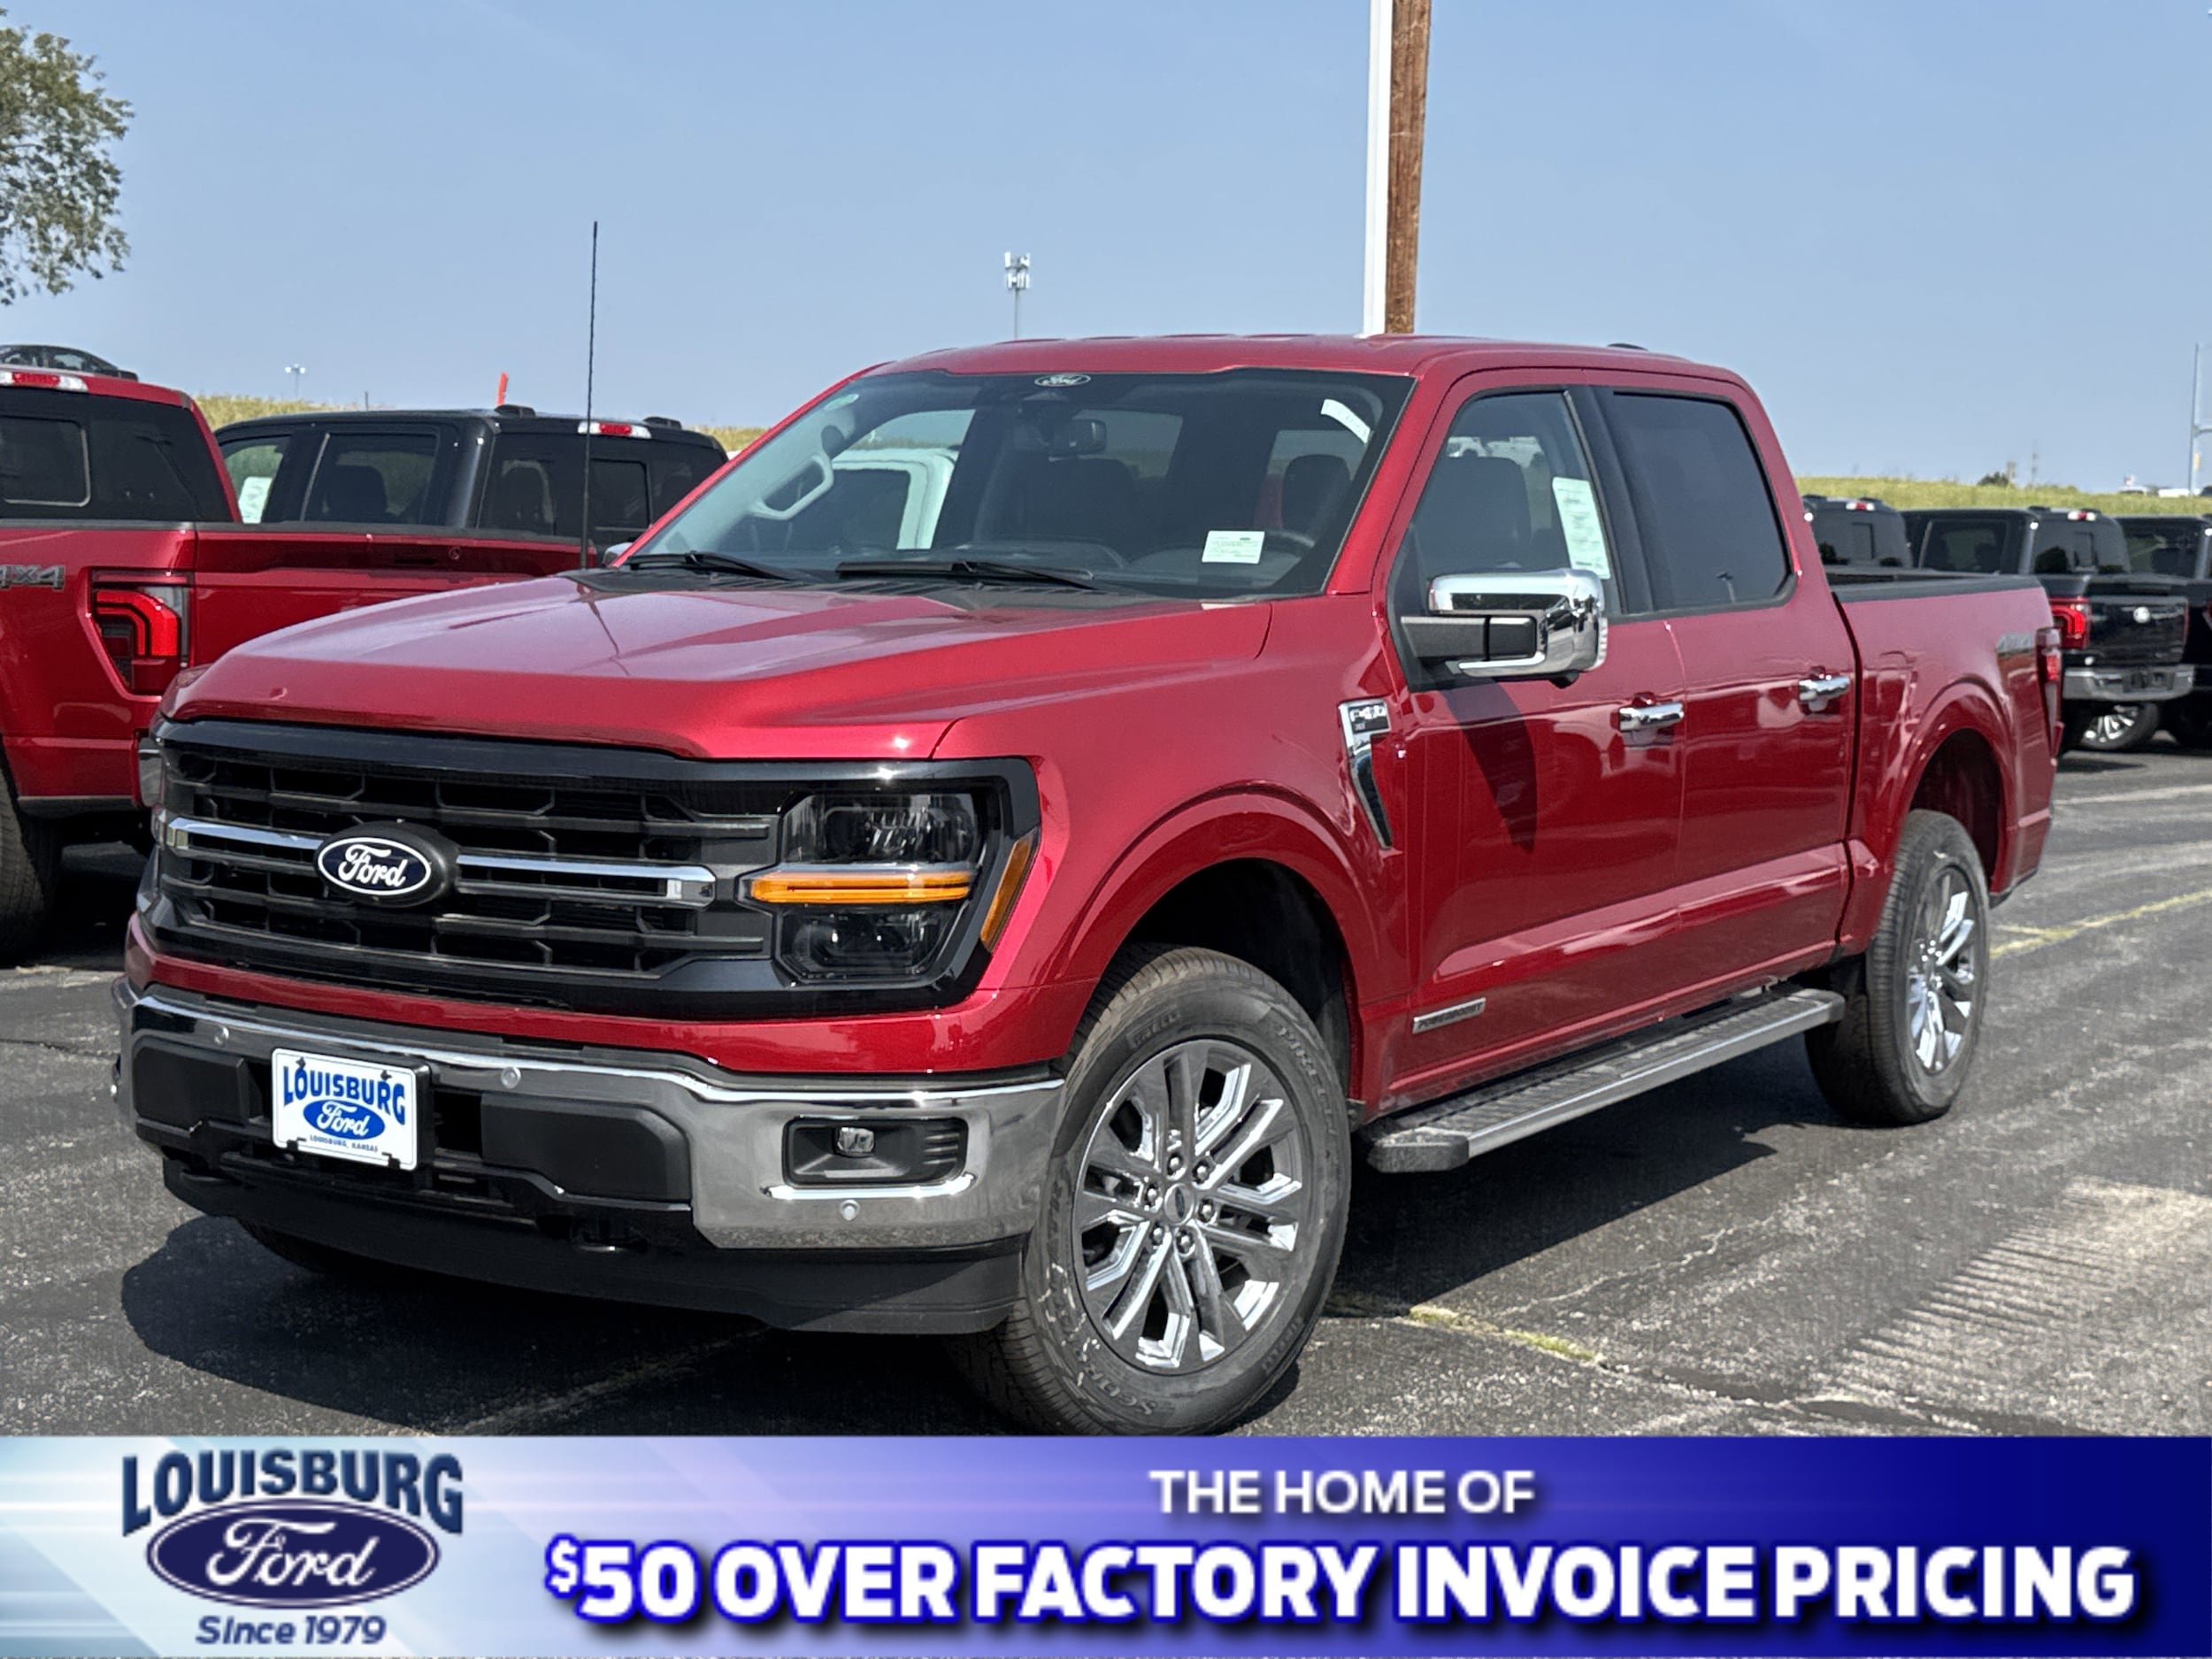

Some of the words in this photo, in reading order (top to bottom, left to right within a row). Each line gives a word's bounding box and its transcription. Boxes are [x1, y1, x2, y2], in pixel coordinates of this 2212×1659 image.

[338, 843, 409, 887] Ford
[283, 1065, 406, 1126] LOUISBURG
[316, 1101, 371, 1137] Ford
